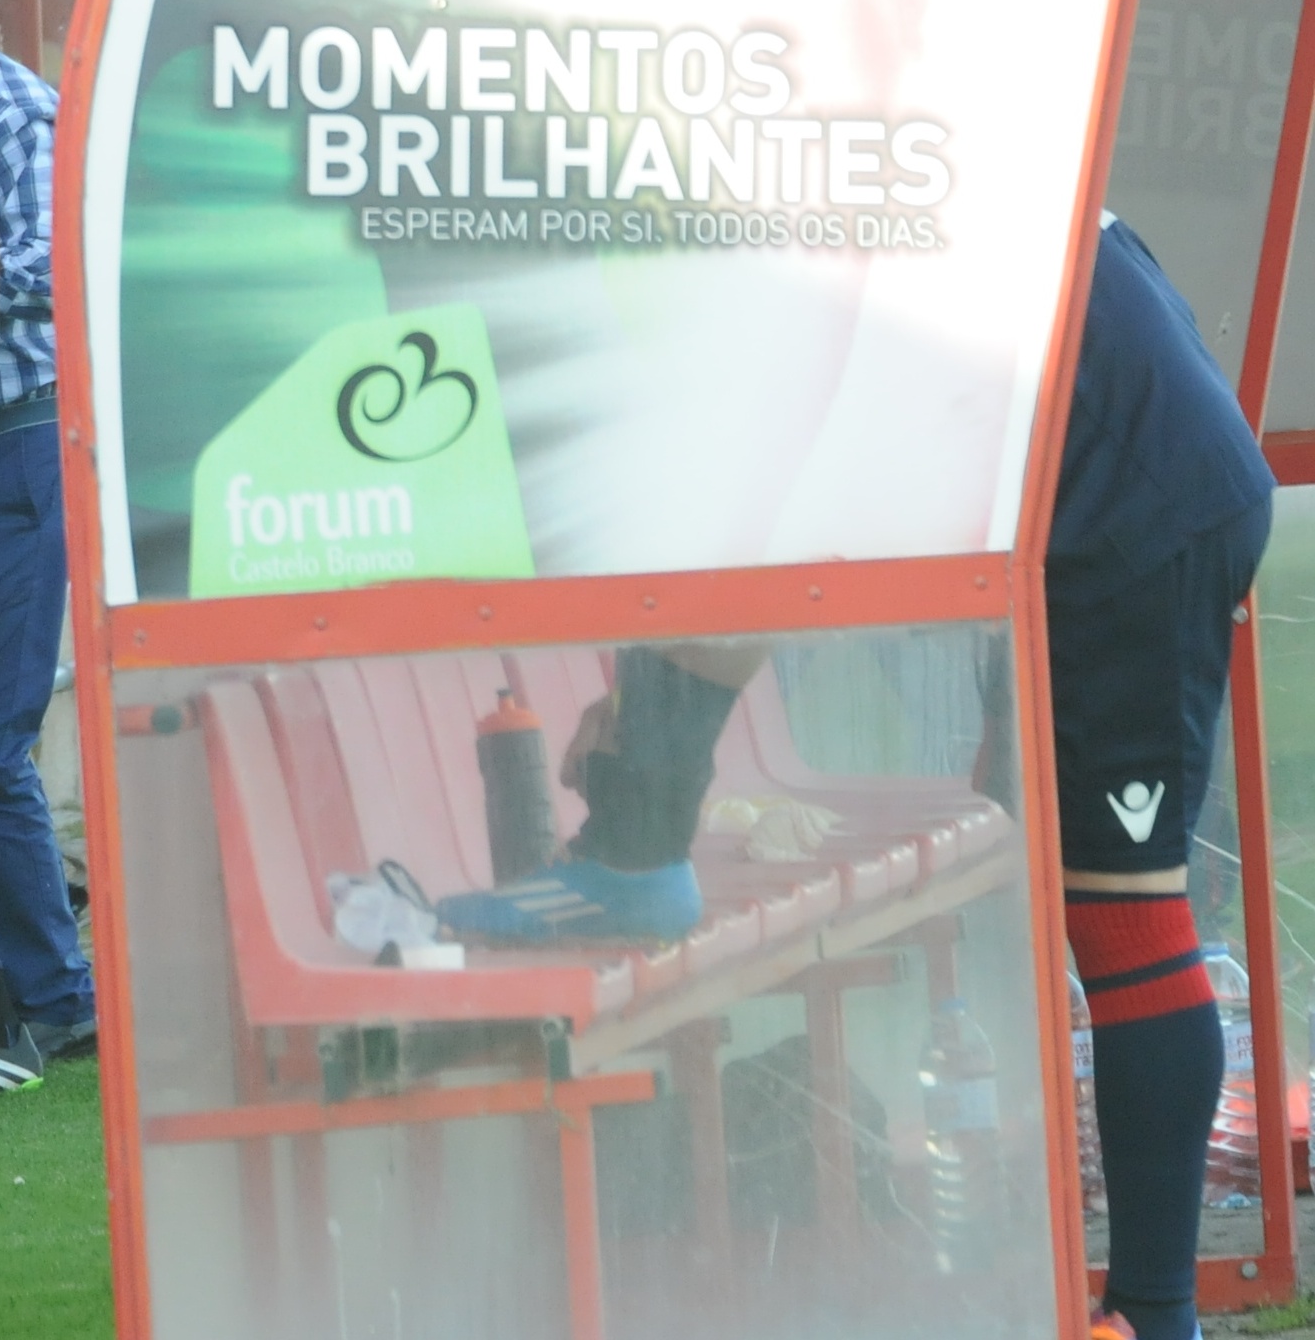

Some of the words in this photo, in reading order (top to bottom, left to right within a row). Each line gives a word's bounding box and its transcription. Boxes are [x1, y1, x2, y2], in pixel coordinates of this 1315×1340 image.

[213, 26, 791, 116] MOMENTOS
[306, 113, 951, 206] BRILHANTES
[361, 206, 528, 241] ESPERAM
[539, 209, 612, 243] POR
[622, 210, 663, 243] SI.
[674, 210, 790, 247] TODOS
[799, 212, 847, 248] OS
[855, 213, 945, 249] DIAS.
[224, 473, 414, 548] forum
[228, 548, 320, 584] Castelo
[326, 544, 415, 577] Branco
